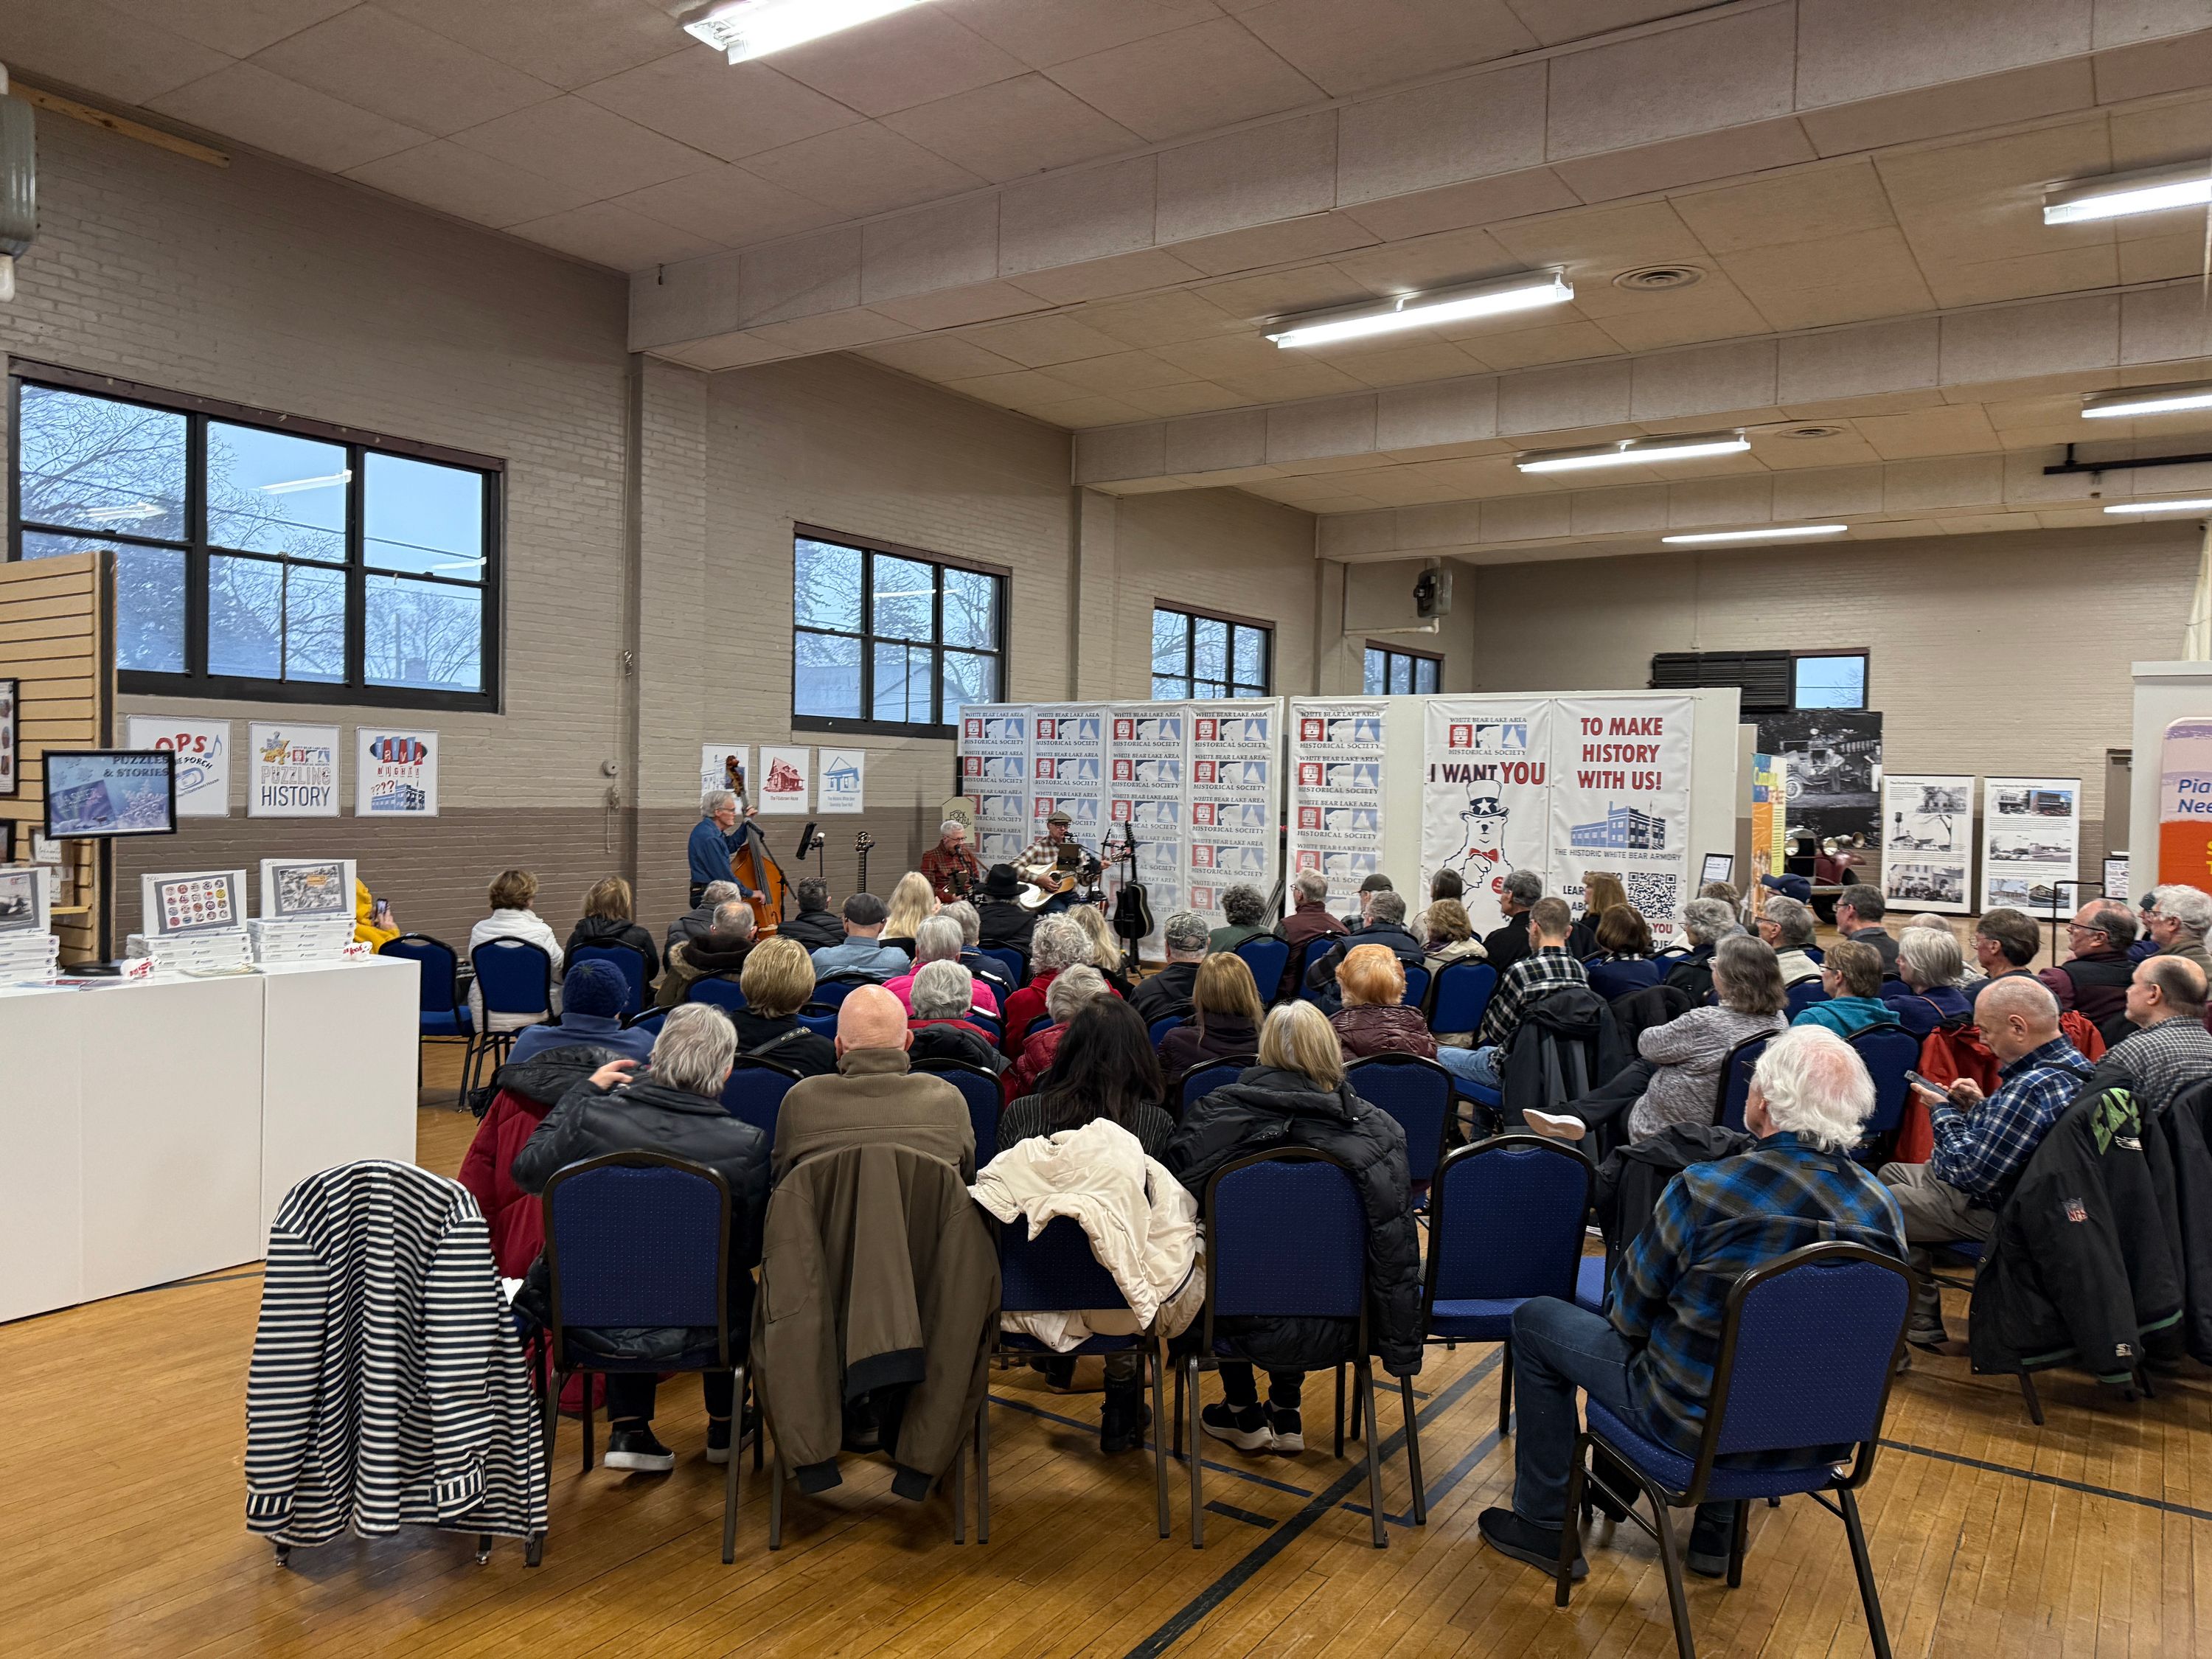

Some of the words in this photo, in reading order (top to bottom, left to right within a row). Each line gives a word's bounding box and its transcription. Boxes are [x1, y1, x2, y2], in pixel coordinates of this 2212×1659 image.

[1581, 717, 1604, 736] TO
[1609, 717, 1663, 736] MAKE
[156, 733, 208, 753] OPS
[113, 755, 170, 765] PUZZLES
[1582, 744, 1661, 763] HISTORY
[184, 757, 212, 770] PORCH
[103, 768, 114, 777] &
[116, 768, 170, 777] STORIES
[261, 765, 331, 785] PUZZLING
[1430, 763, 1436, 782] I
[1442, 763, 1498, 783] WANT
[1500, 762, 1545, 785] YOU
[1577, 771, 1624, 789] WITH
[1632, 771, 1662, 790] US!
[2177, 778, 2211, 793] Pia
[261, 786, 330, 807] HISTORY
[2177, 799, 2212, 813] Nee
[1570, 849, 1601, 858] HISTORIC
[1604, 850, 1627, 858] WHITE
[1650, 852, 1682, 861] ARMORY
[1562, 885, 1585, 895] LEAR
[1652, 923, 1673, 934] YOU
